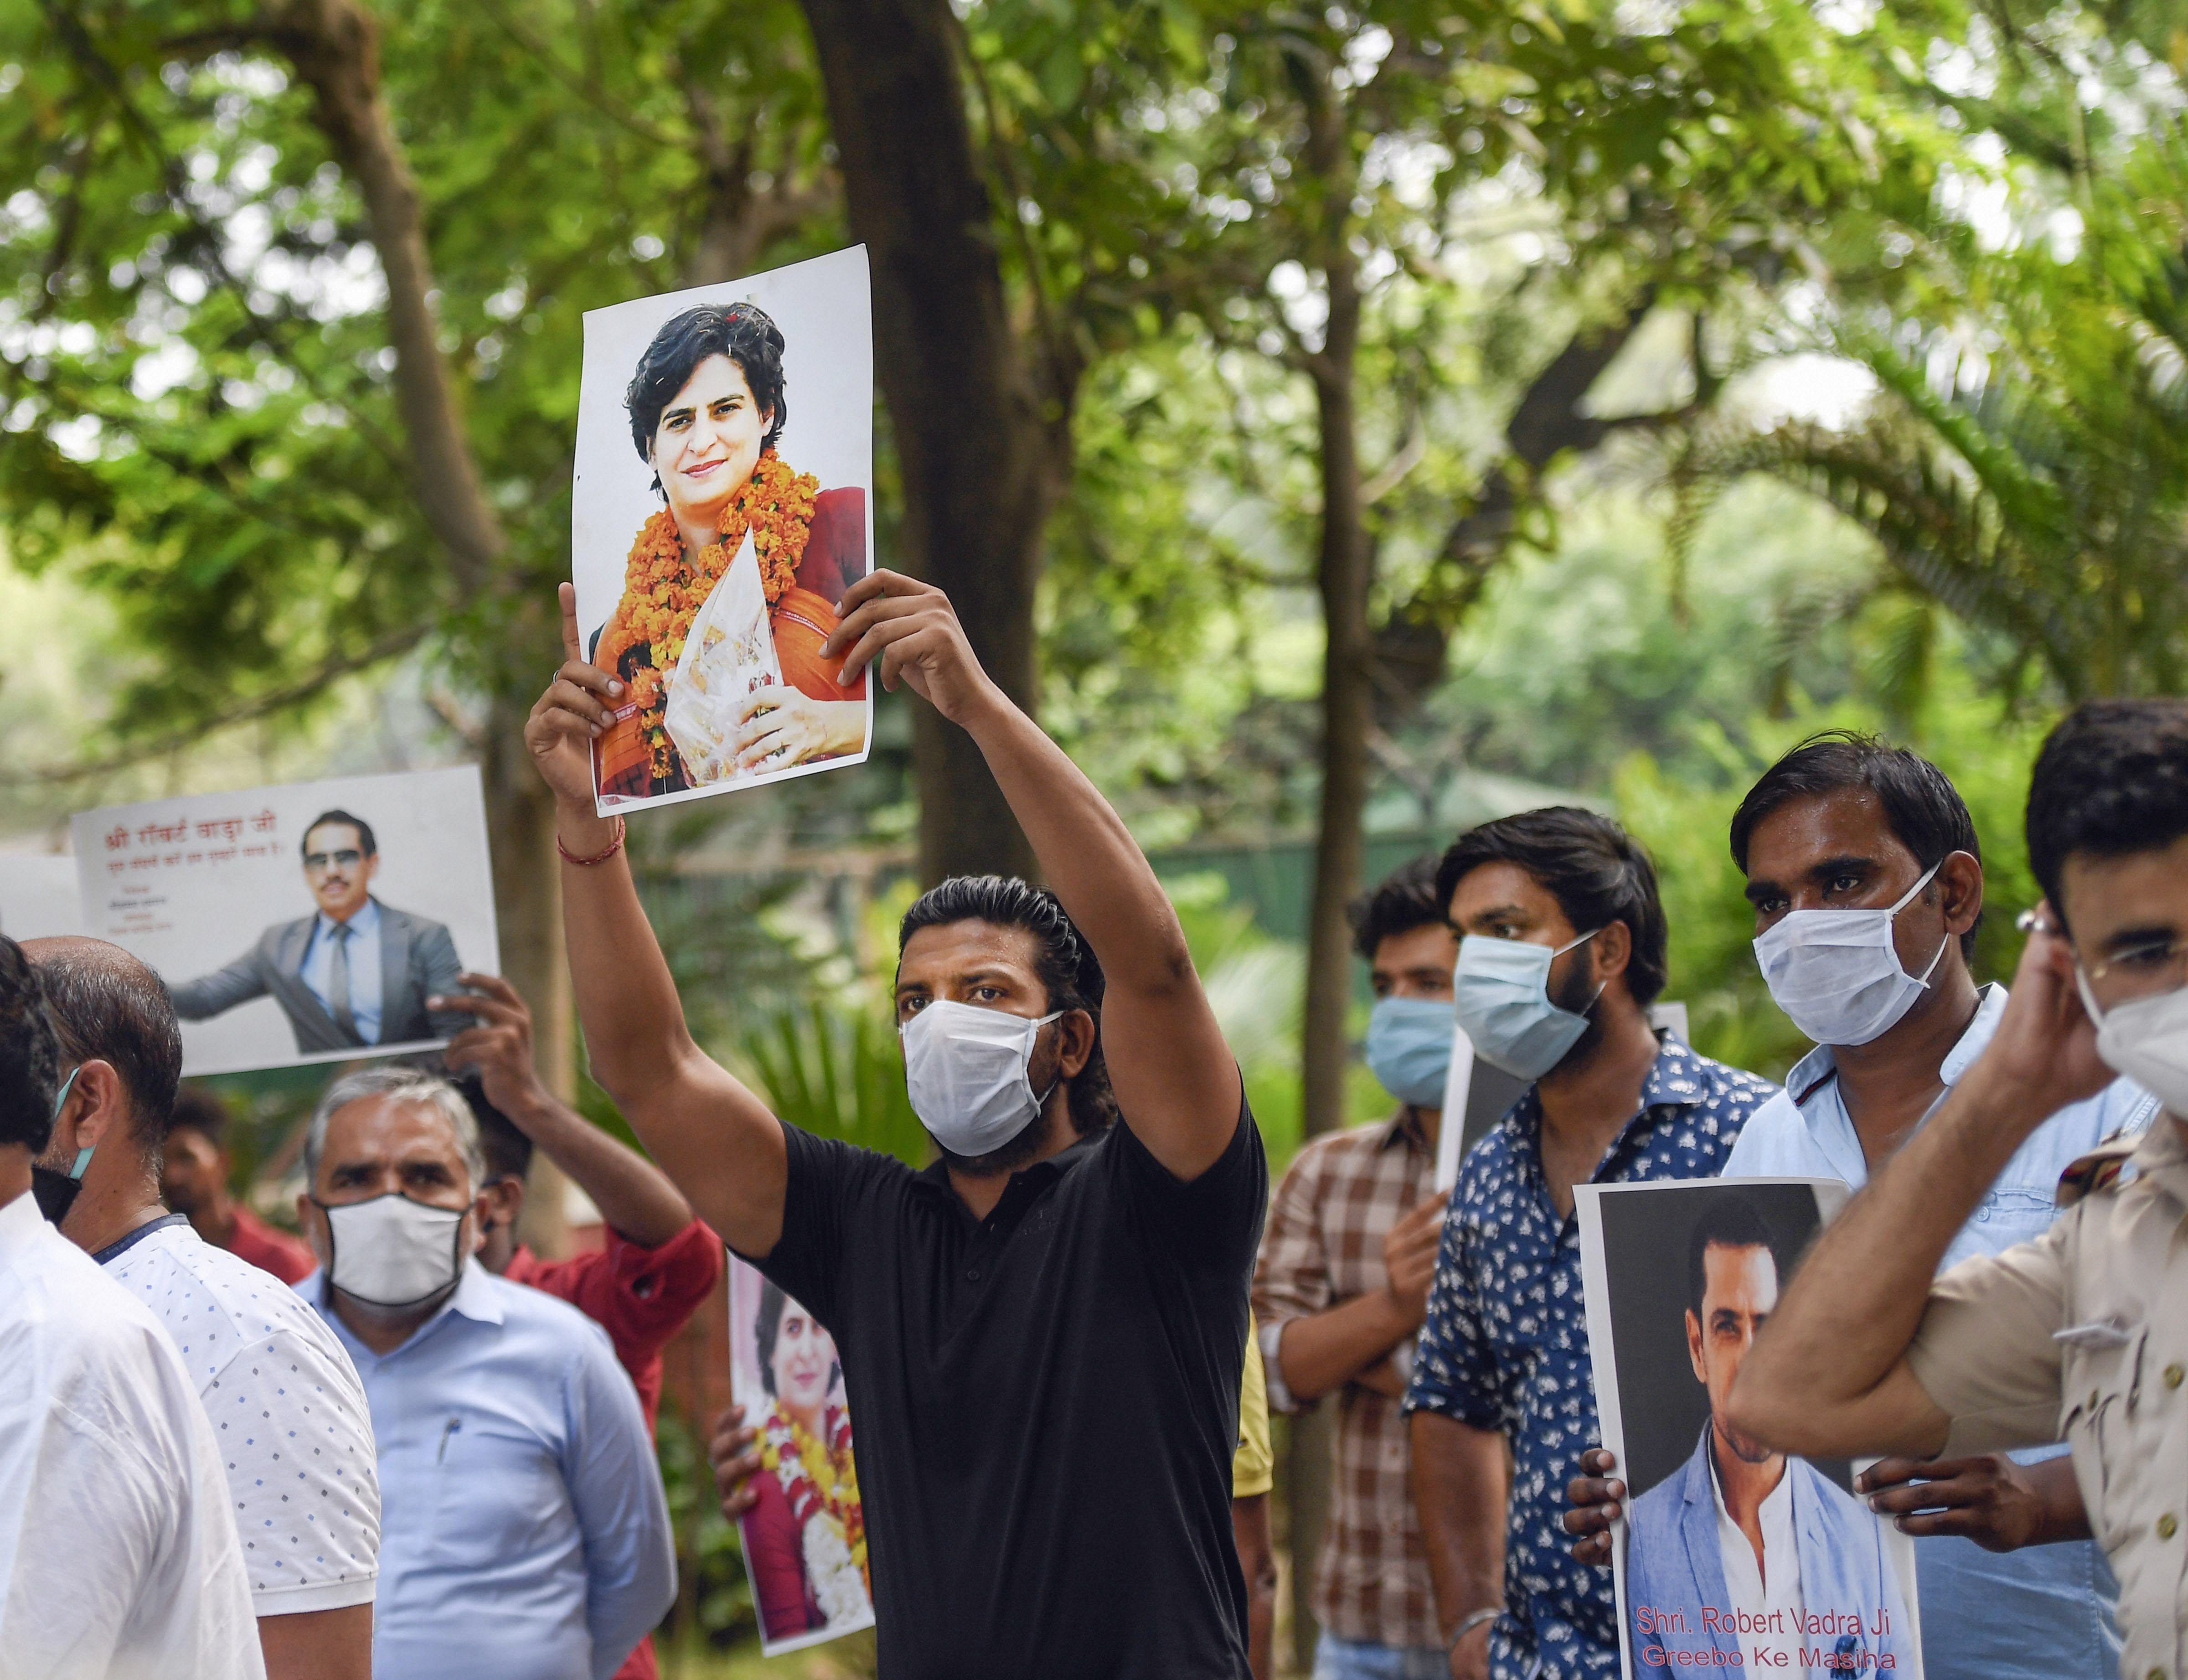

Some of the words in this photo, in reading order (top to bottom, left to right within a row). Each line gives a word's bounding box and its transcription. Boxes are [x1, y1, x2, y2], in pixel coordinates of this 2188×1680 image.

[105, 826, 129, 851] श्री
[249, 809, 276, 832] जी
[1637, 1607, 1692, 1633] Shri.
[1701, 1607, 1785, 1633] Robert
[1790, 1608, 1862, 1635] Vadra
[1870, 1608, 1890, 1635] Ji
[1643, 1645, 1744, 1666] Greebo
[1754, 1647, 1789, 1667] Ke
[1798, 1647, 1896, 1669] Masiha
